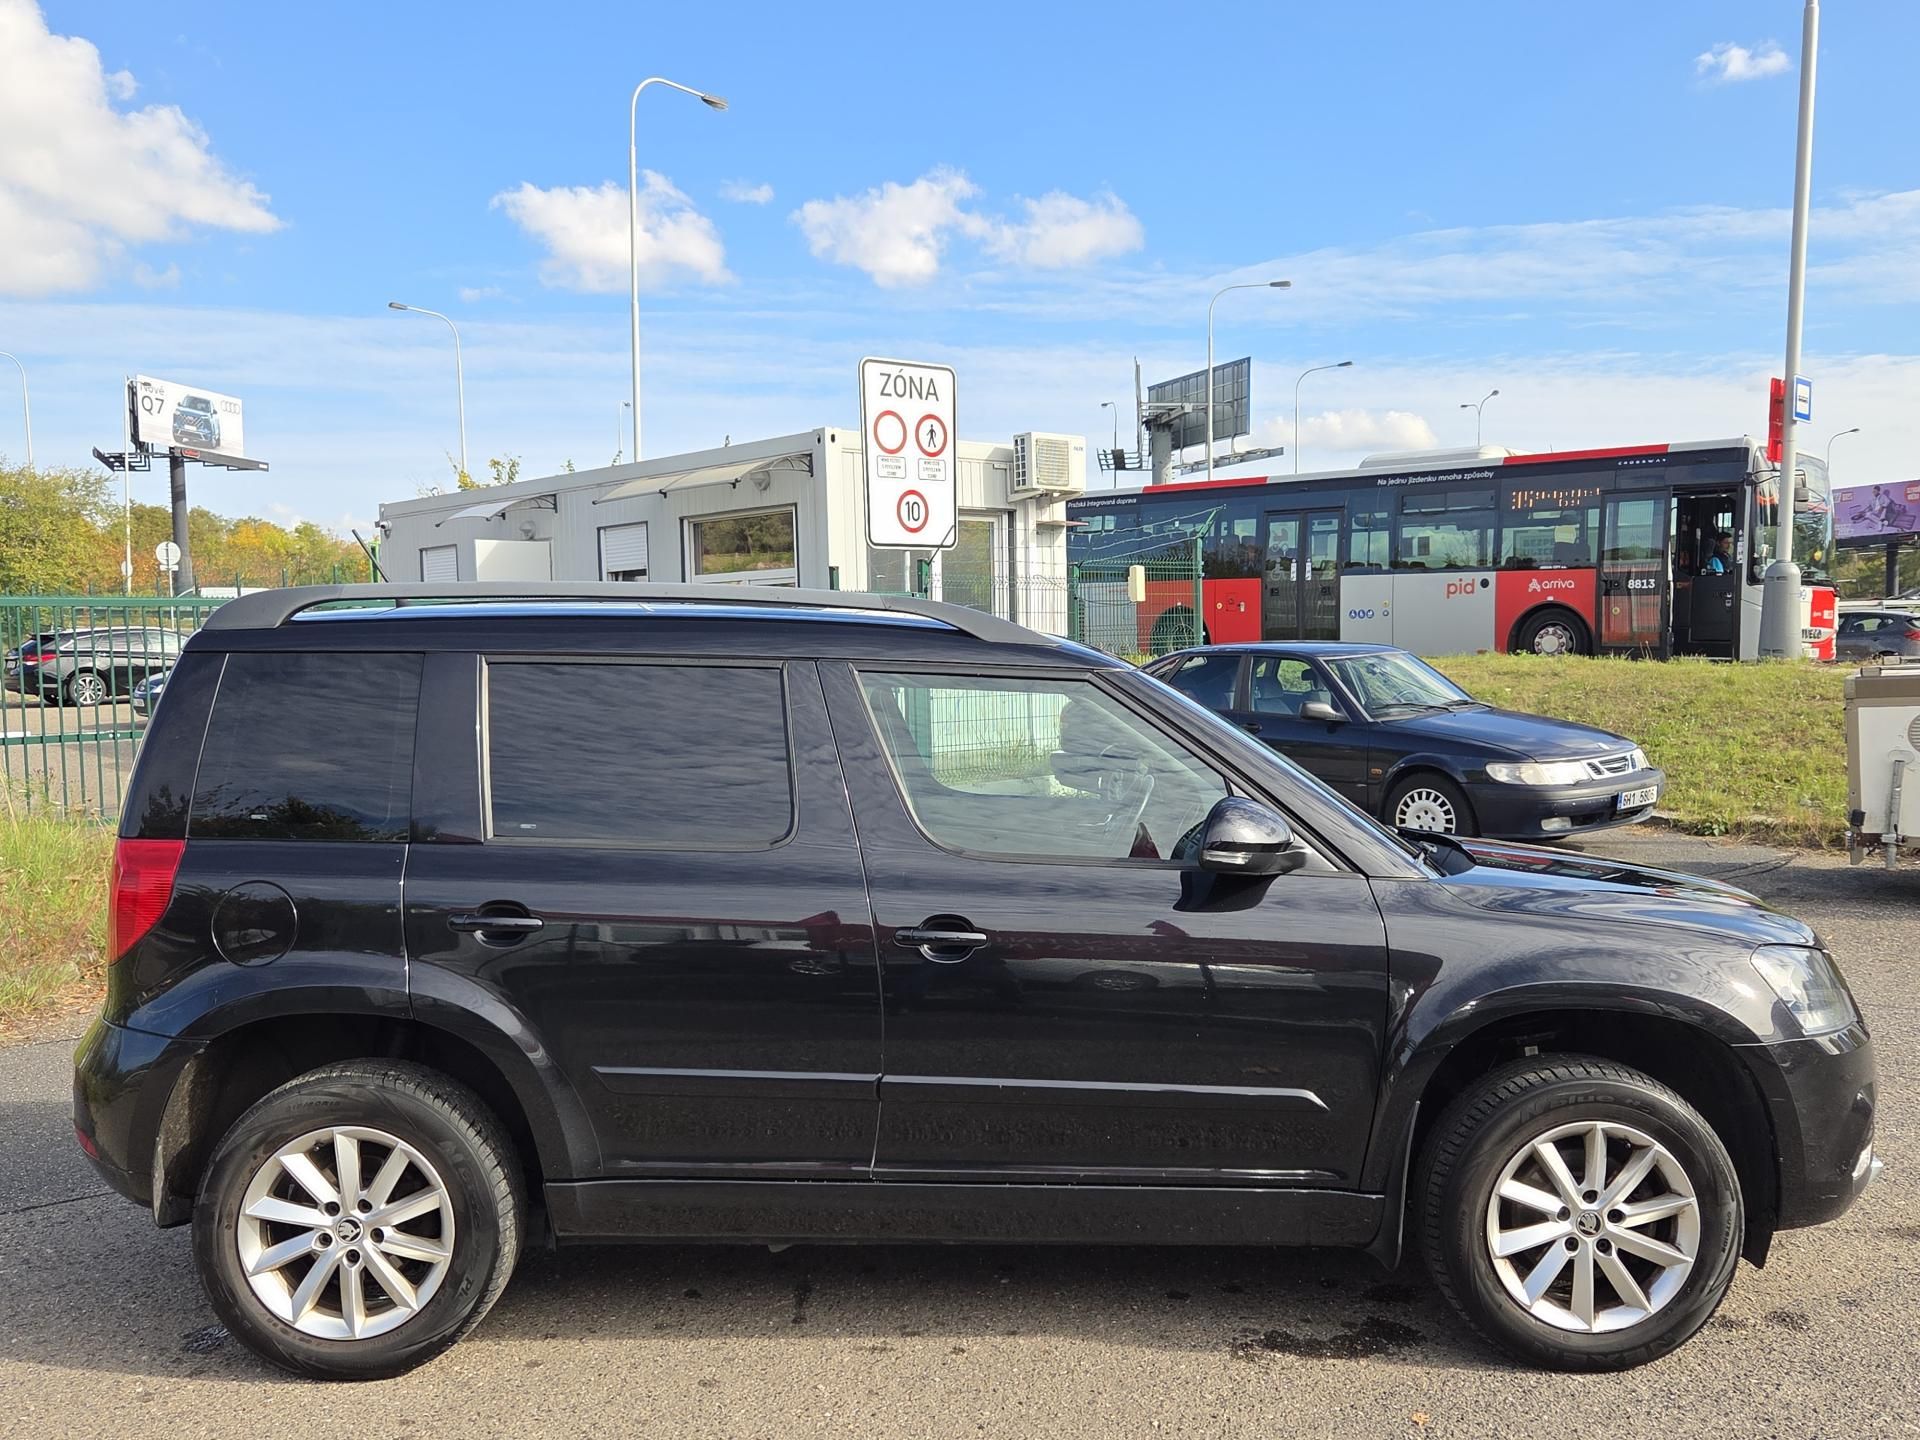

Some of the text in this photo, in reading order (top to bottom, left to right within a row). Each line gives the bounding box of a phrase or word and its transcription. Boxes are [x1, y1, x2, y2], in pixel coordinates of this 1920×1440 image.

[879, 369, 939, 402] ZÓNA
[141, 395, 165, 416] Q7
[904, 501, 921, 522] 10
[1446, 578, 1475, 599] pid
[1541, 578, 1575, 590] arriva
[1627, 578, 1656, 589] 8813
